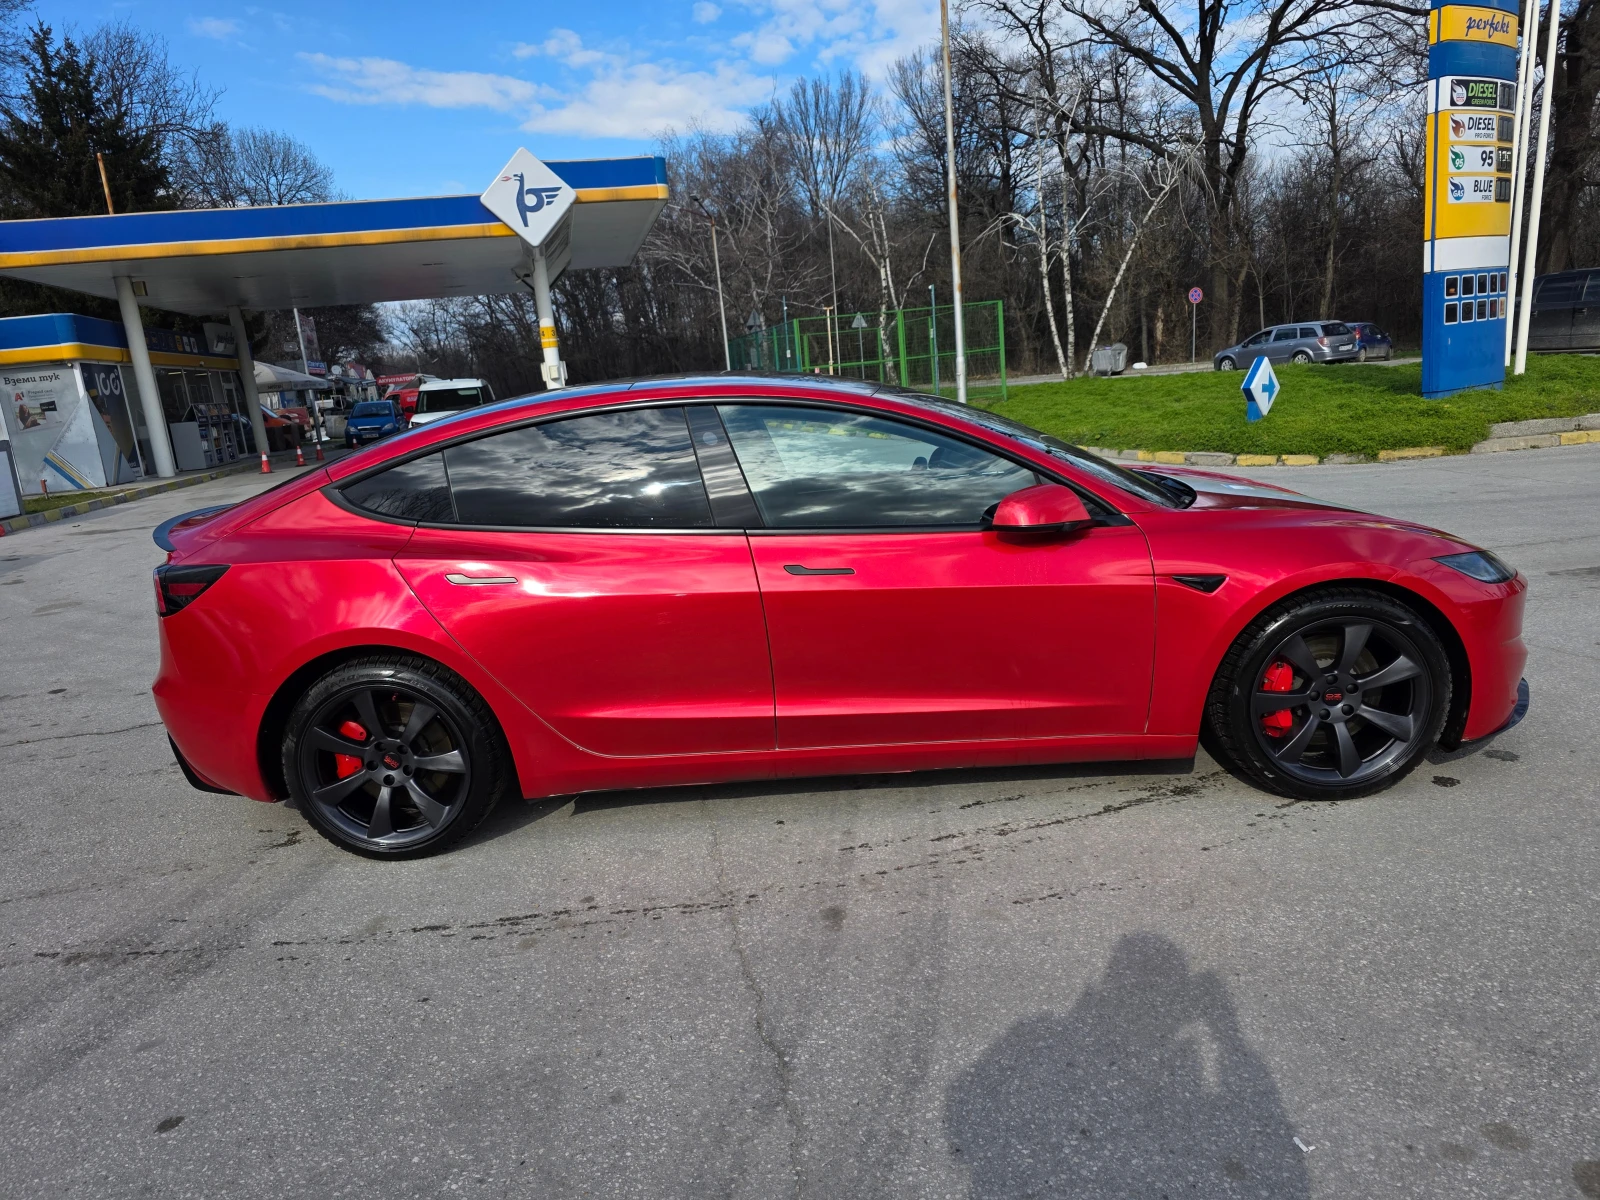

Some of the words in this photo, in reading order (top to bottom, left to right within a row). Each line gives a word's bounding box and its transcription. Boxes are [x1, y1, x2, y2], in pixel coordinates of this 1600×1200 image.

[1465, 13, 1510, 39] perfekt
[1467, 82, 1496, 98] DIESEL
[1467, 116, 1495, 131] DIESEL
[1460, 127, 1464, 136] D
[1455, 158, 1464, 168] 95
[1480, 149, 1494, 167] 95
[1453, 189, 1464, 197] GAS
[1473, 179, 1493, 193] BLUE
[2, 375, 37, 386] Вземи
[38, 372, 61, 383] тук
[14, 391, 25, 402] A1
